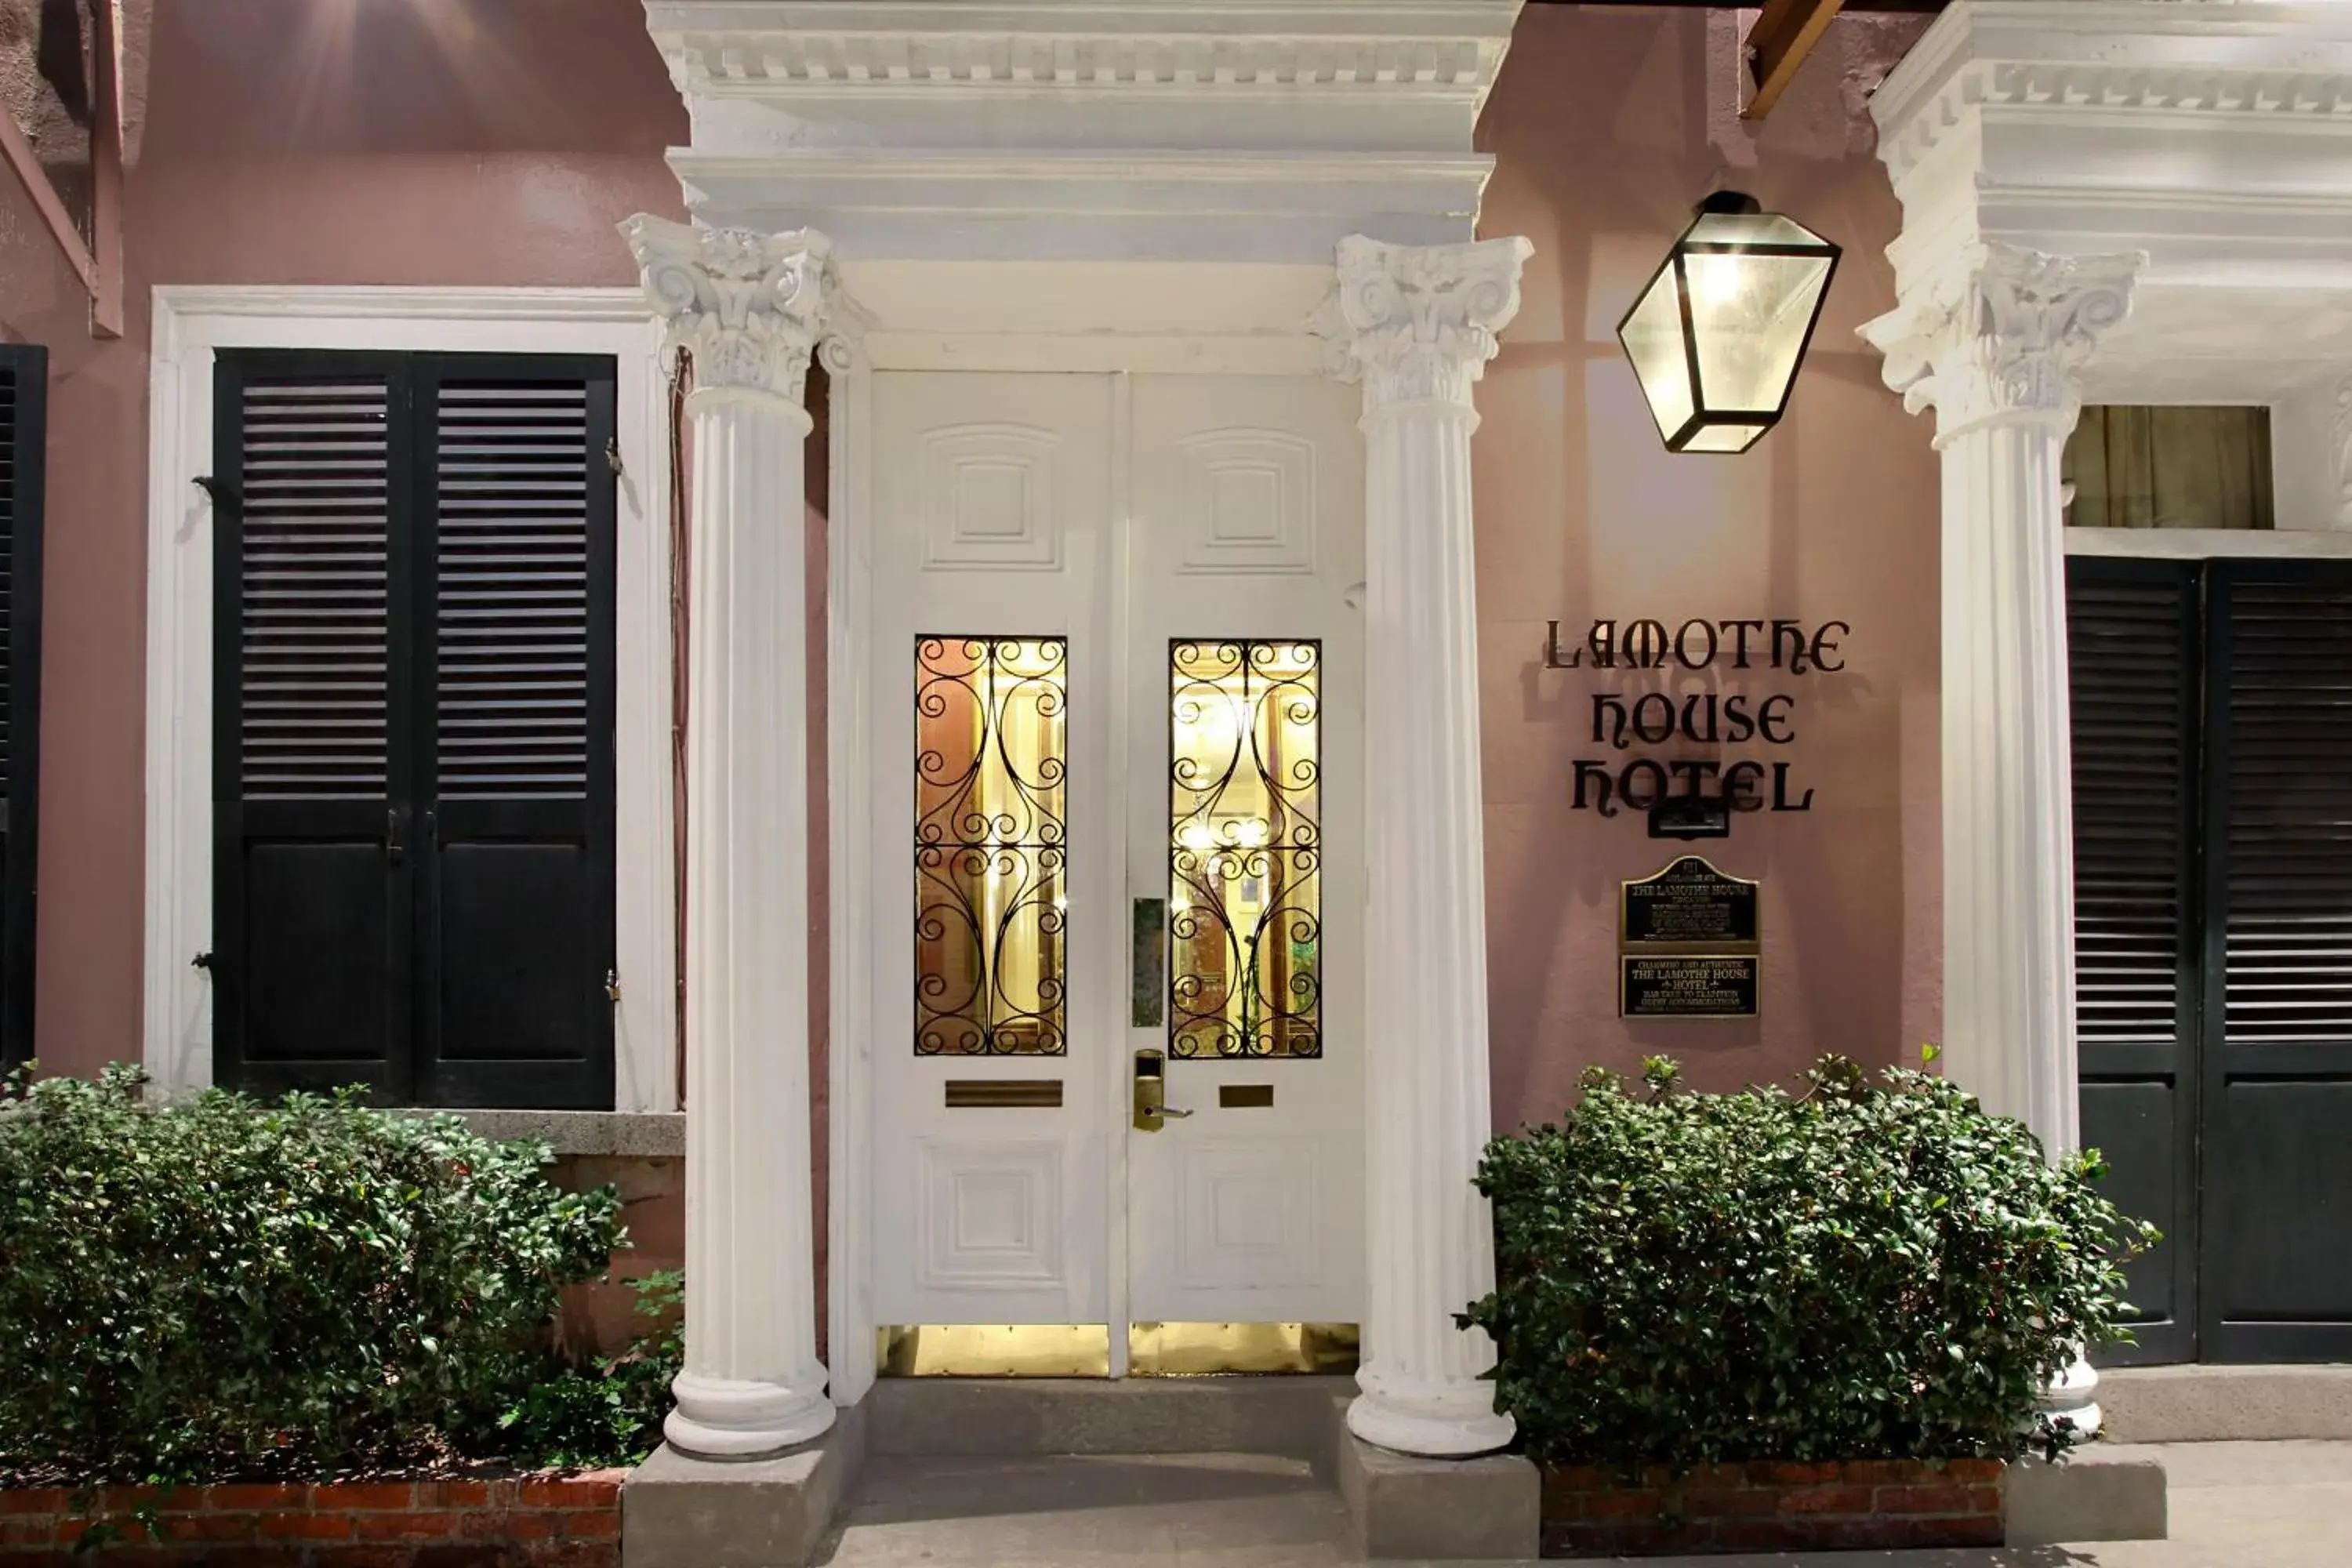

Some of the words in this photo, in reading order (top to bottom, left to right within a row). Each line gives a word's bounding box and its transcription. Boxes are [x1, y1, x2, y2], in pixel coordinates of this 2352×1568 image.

[1546, 619, 1850, 674] LAMOTHE
[1592, 692, 1795, 750] HOUSE
[1571, 759, 1815, 817] HOTEL
[1632, 885, 1655, 896] THE
[1657, 885, 1710, 896] LAMOTHE
[1632, 969, 1655, 979] THE
[1657, 969, 1710, 979] LAMOTHE
[1713, 968, 1750, 979] HOUSE
[1673, 979, 1709, 990] HOTEL
